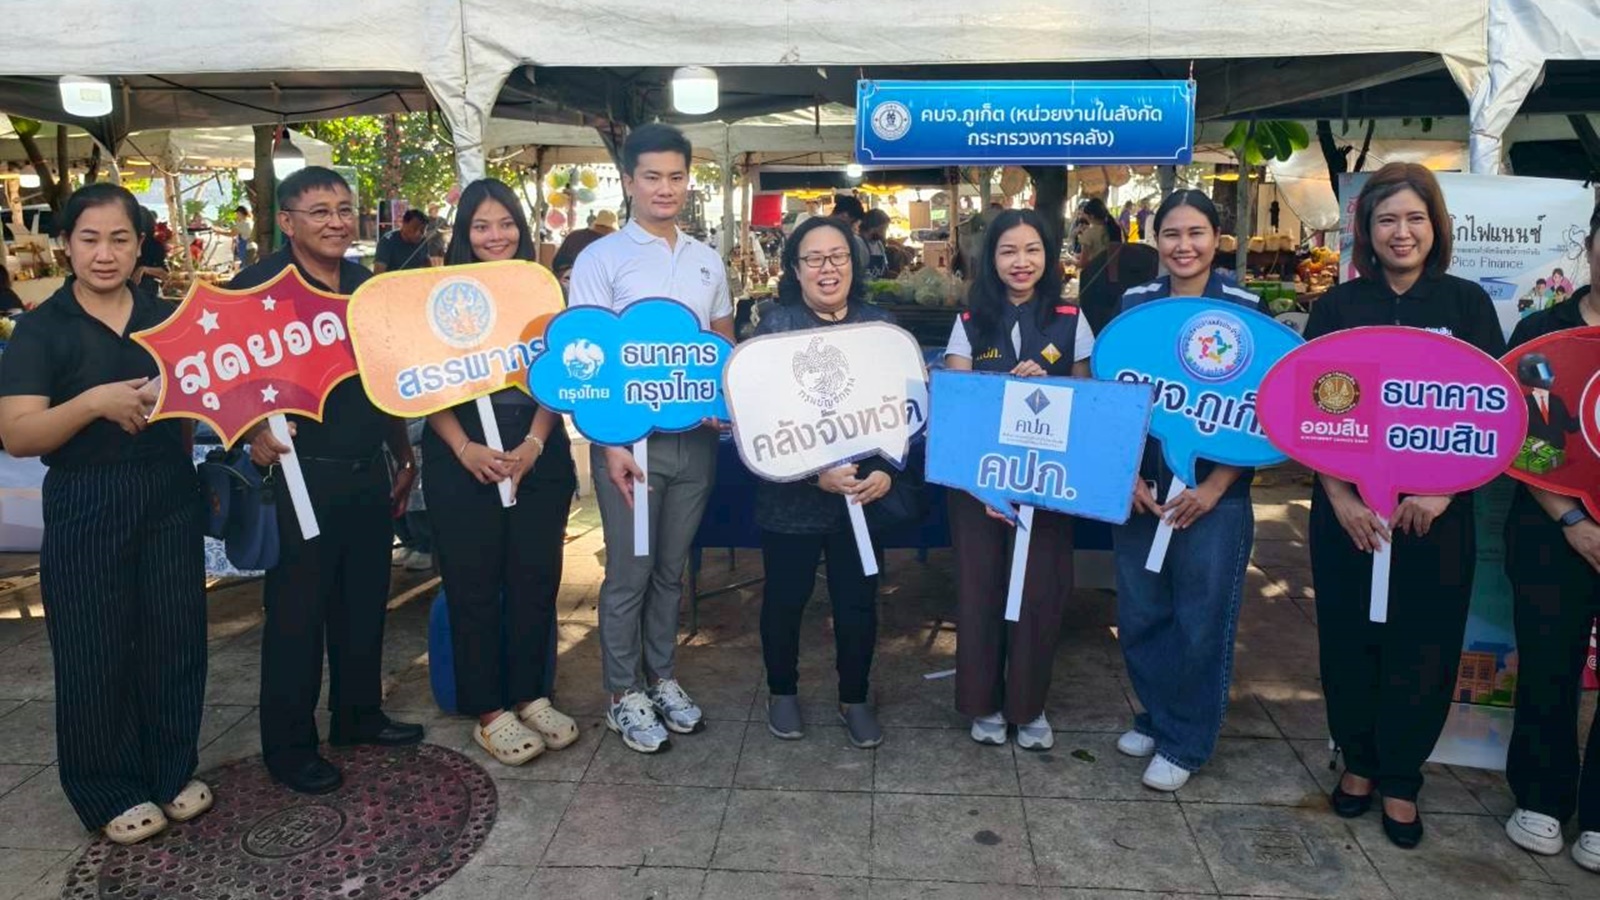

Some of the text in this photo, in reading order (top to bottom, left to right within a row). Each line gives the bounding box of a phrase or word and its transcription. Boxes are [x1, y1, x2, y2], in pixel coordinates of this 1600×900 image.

[921, 103, 1005, 127] คบจ.ภูเก็ต
[1010, 101, 1163, 124] (หน่วยงานในสังกัด
[968, 129, 1114, 147] กระทรวงการคลัง)
[1452, 256, 1523, 269] Pico Finance
[175, 311, 346, 411] สุดยอด
[623, 344, 717, 366] ธนาคาร
[559, 385, 610, 404] กรุงไทย
[626, 372, 715, 410] กรุงไทย
[1382, 381, 1507, 412] ธนาคาร
[753, 395, 923, 462] คลังจังหวัด
[1301, 418, 1369, 437] ออมสิน
[1388, 425, 1495, 456] ออมสิน
[979, 451, 1075, 498] คปภ.
